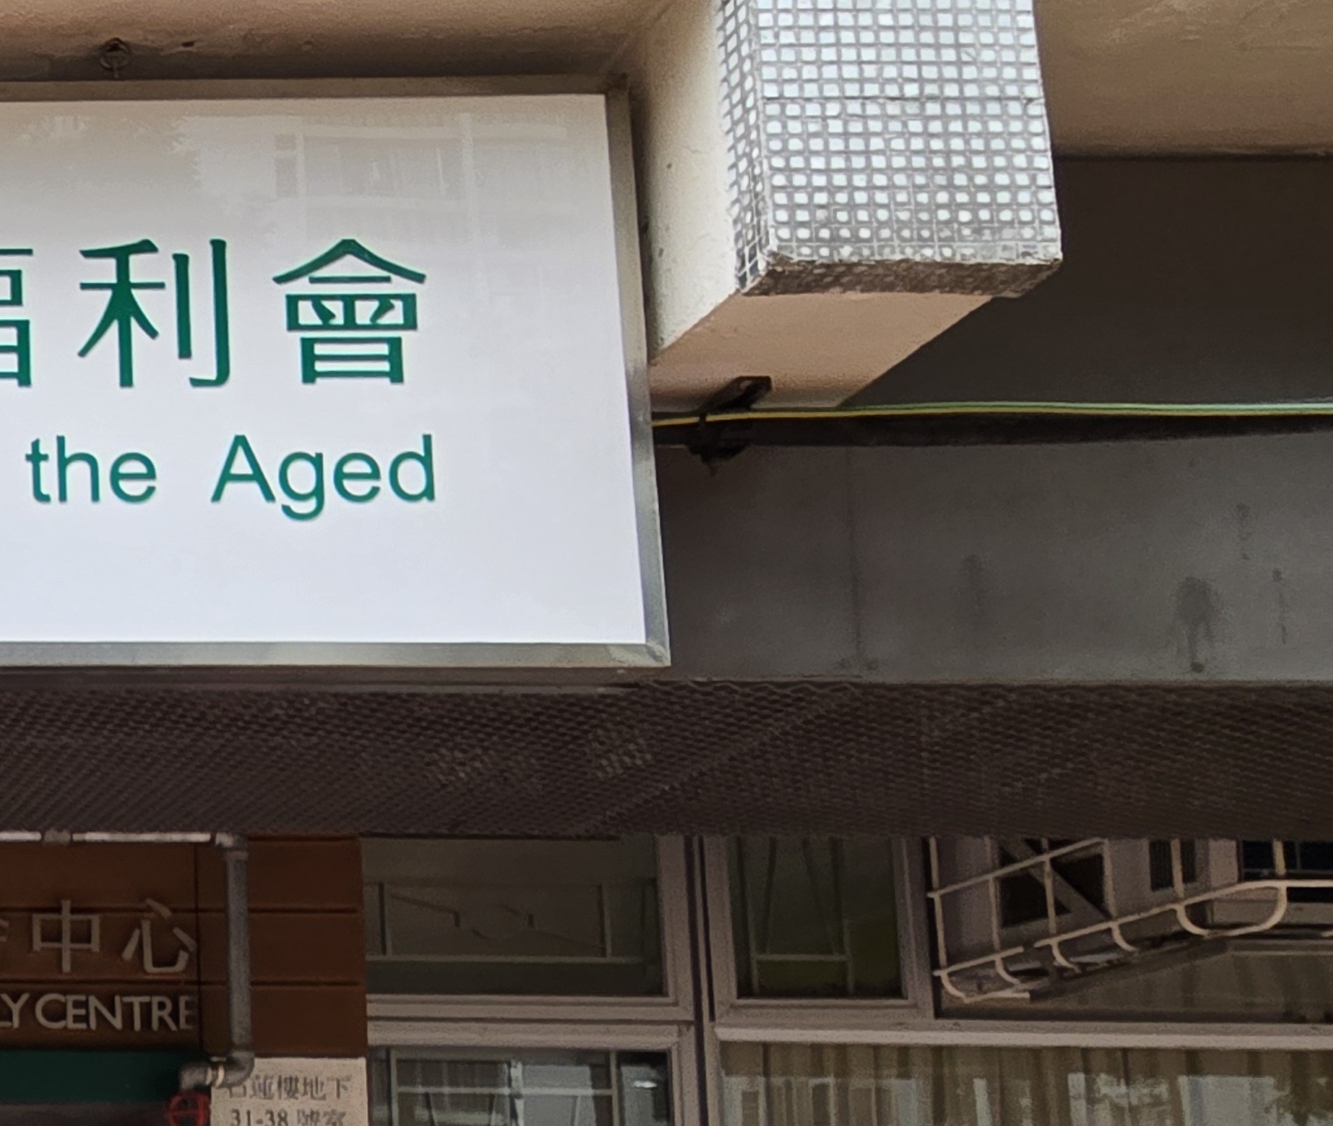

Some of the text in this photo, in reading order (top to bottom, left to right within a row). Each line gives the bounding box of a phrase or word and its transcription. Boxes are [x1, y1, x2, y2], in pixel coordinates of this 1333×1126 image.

[28, 437, 156, 502] the
[213, 435, 434, 520] Aged
[35, 993, 195, 1032] CENTRE
